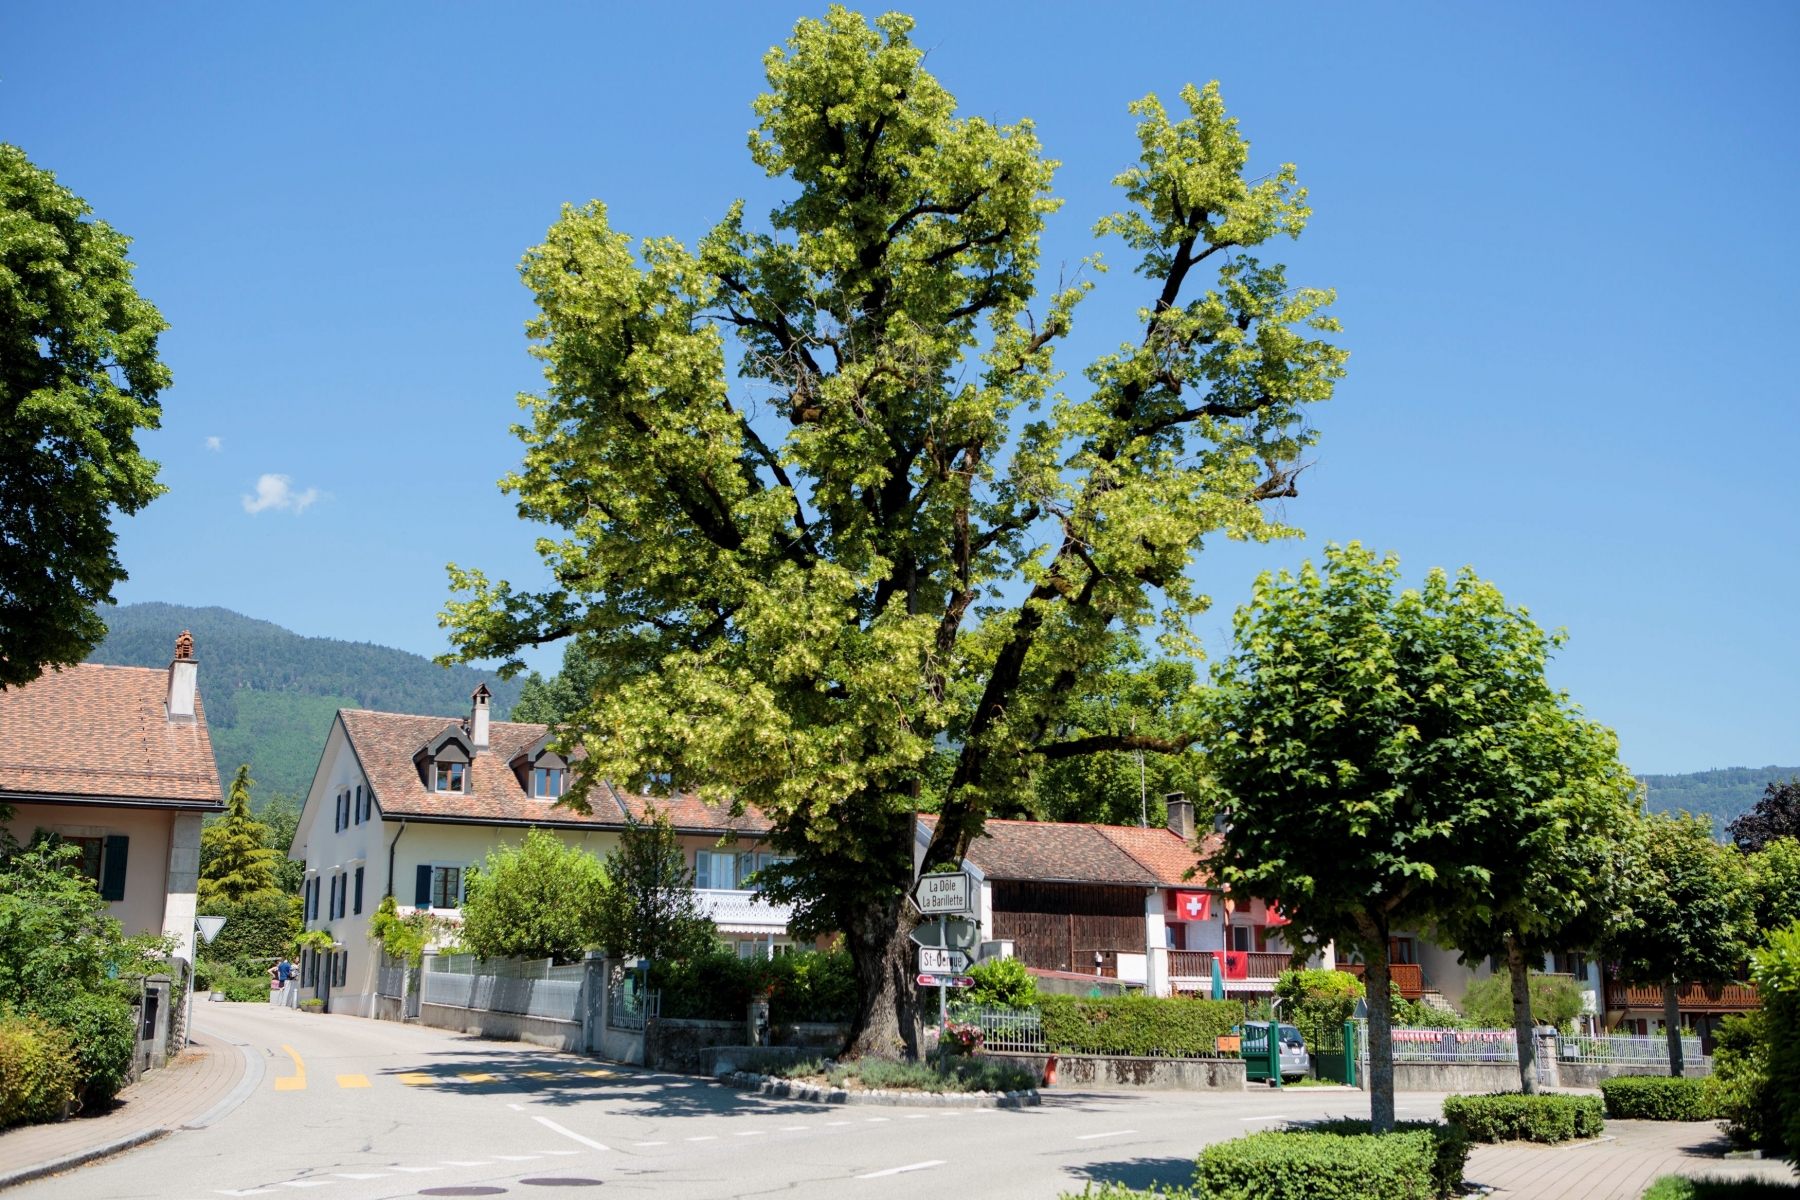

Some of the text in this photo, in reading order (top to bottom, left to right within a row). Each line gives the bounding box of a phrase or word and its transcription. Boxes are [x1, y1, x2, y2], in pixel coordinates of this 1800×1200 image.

[929, 879, 956, 892] La Dôle
[922, 894, 963, 907] La Barillette
